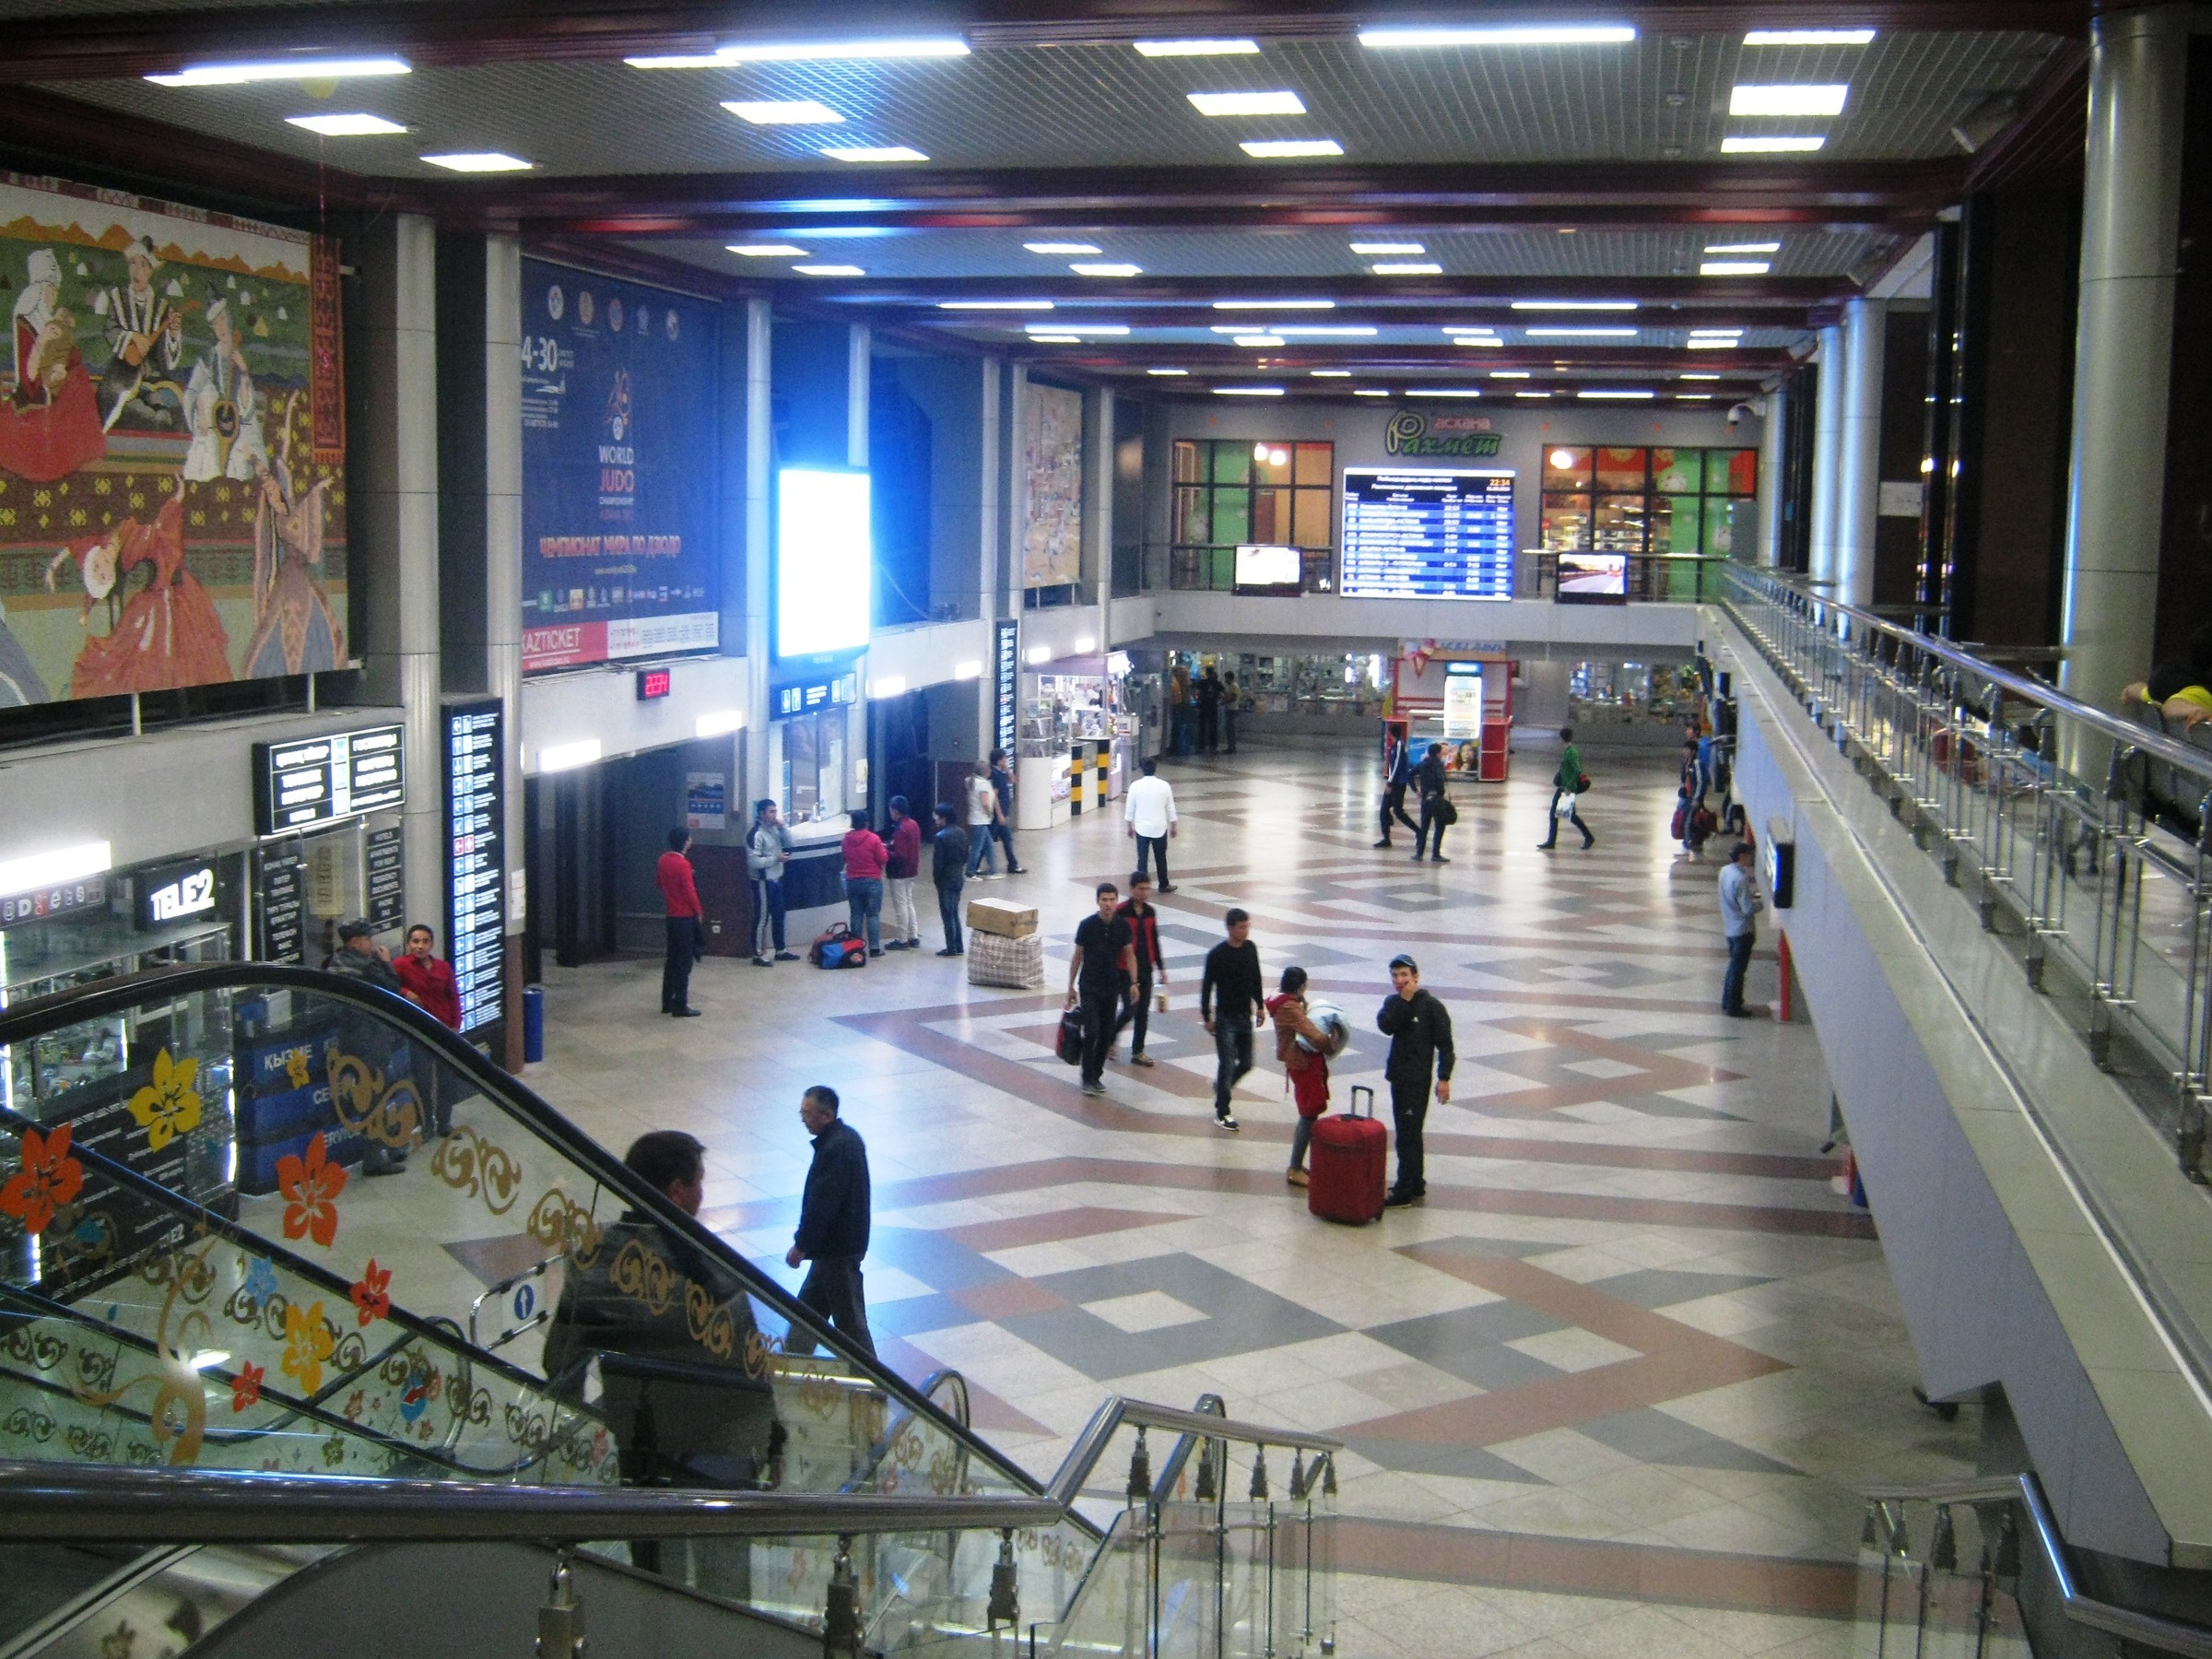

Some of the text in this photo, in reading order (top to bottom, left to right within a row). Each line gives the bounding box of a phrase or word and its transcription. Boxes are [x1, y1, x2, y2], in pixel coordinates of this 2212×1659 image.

[599, 445, 634, 465] WORLD
[600, 469, 635, 492] JUDO
[1488, 478, 1511, 487] 22:34
[150, 868, 216, 921] TELE2
